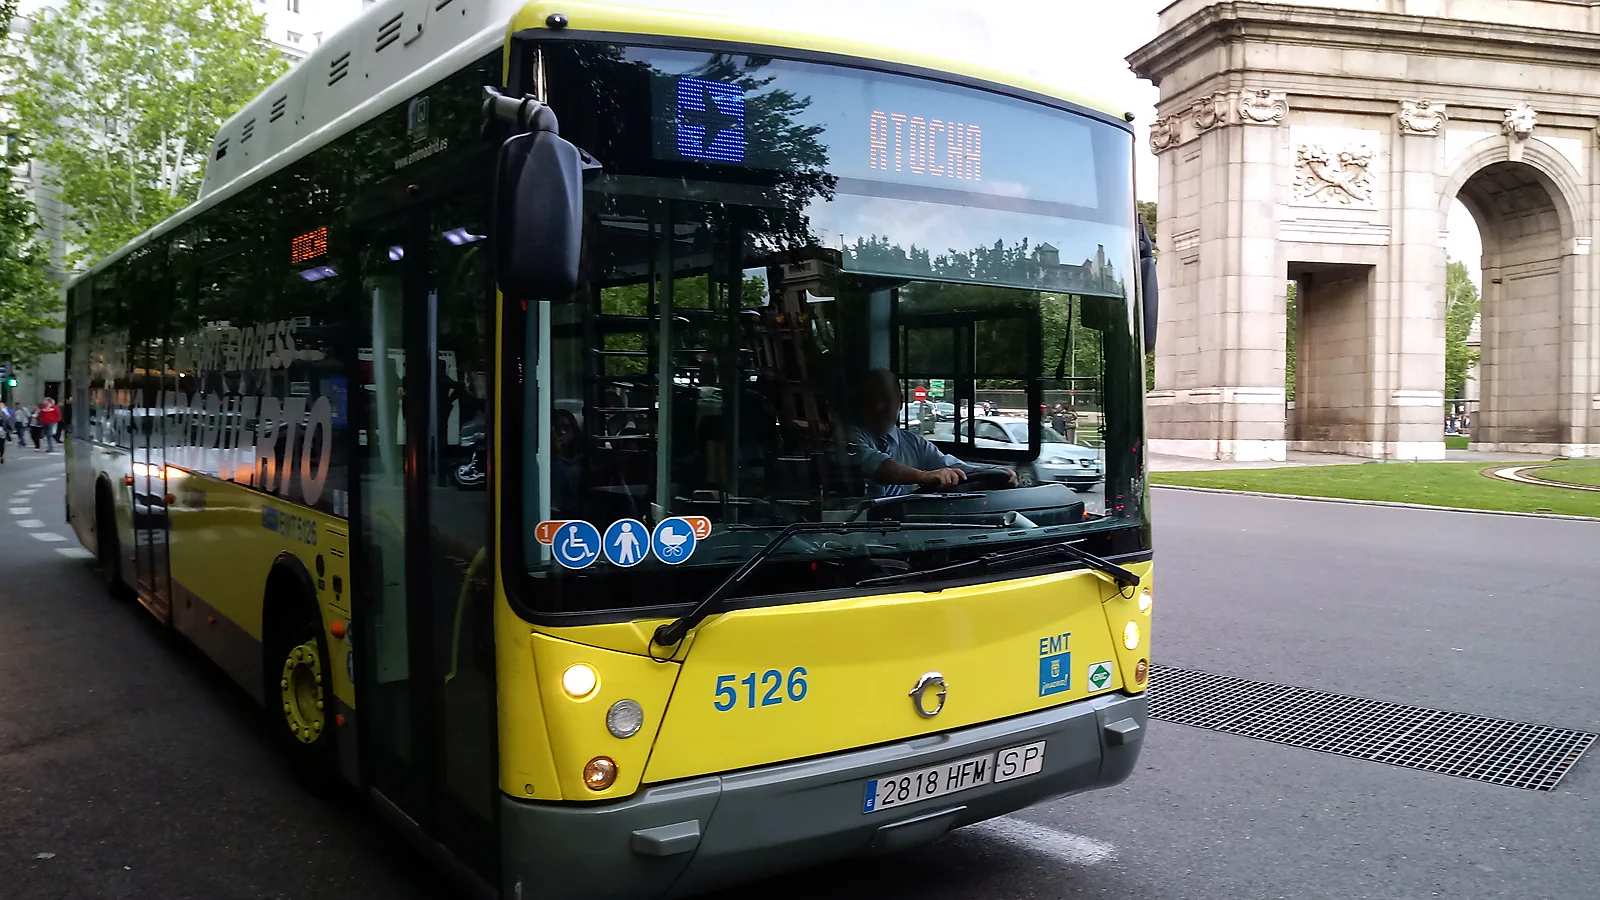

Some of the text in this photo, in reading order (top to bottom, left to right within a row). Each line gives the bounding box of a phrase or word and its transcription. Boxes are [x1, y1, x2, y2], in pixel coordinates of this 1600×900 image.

[870, 109, 981, 181] ATOCHA
[541, 524, 550, 538] 1
[696, 519, 707, 533] 2
[1039, 632, 1071, 655] EMT
[713, 666, 808, 712] 5126
[882, 770, 939, 806] 2818
[946, 758, 987, 790] HFM
